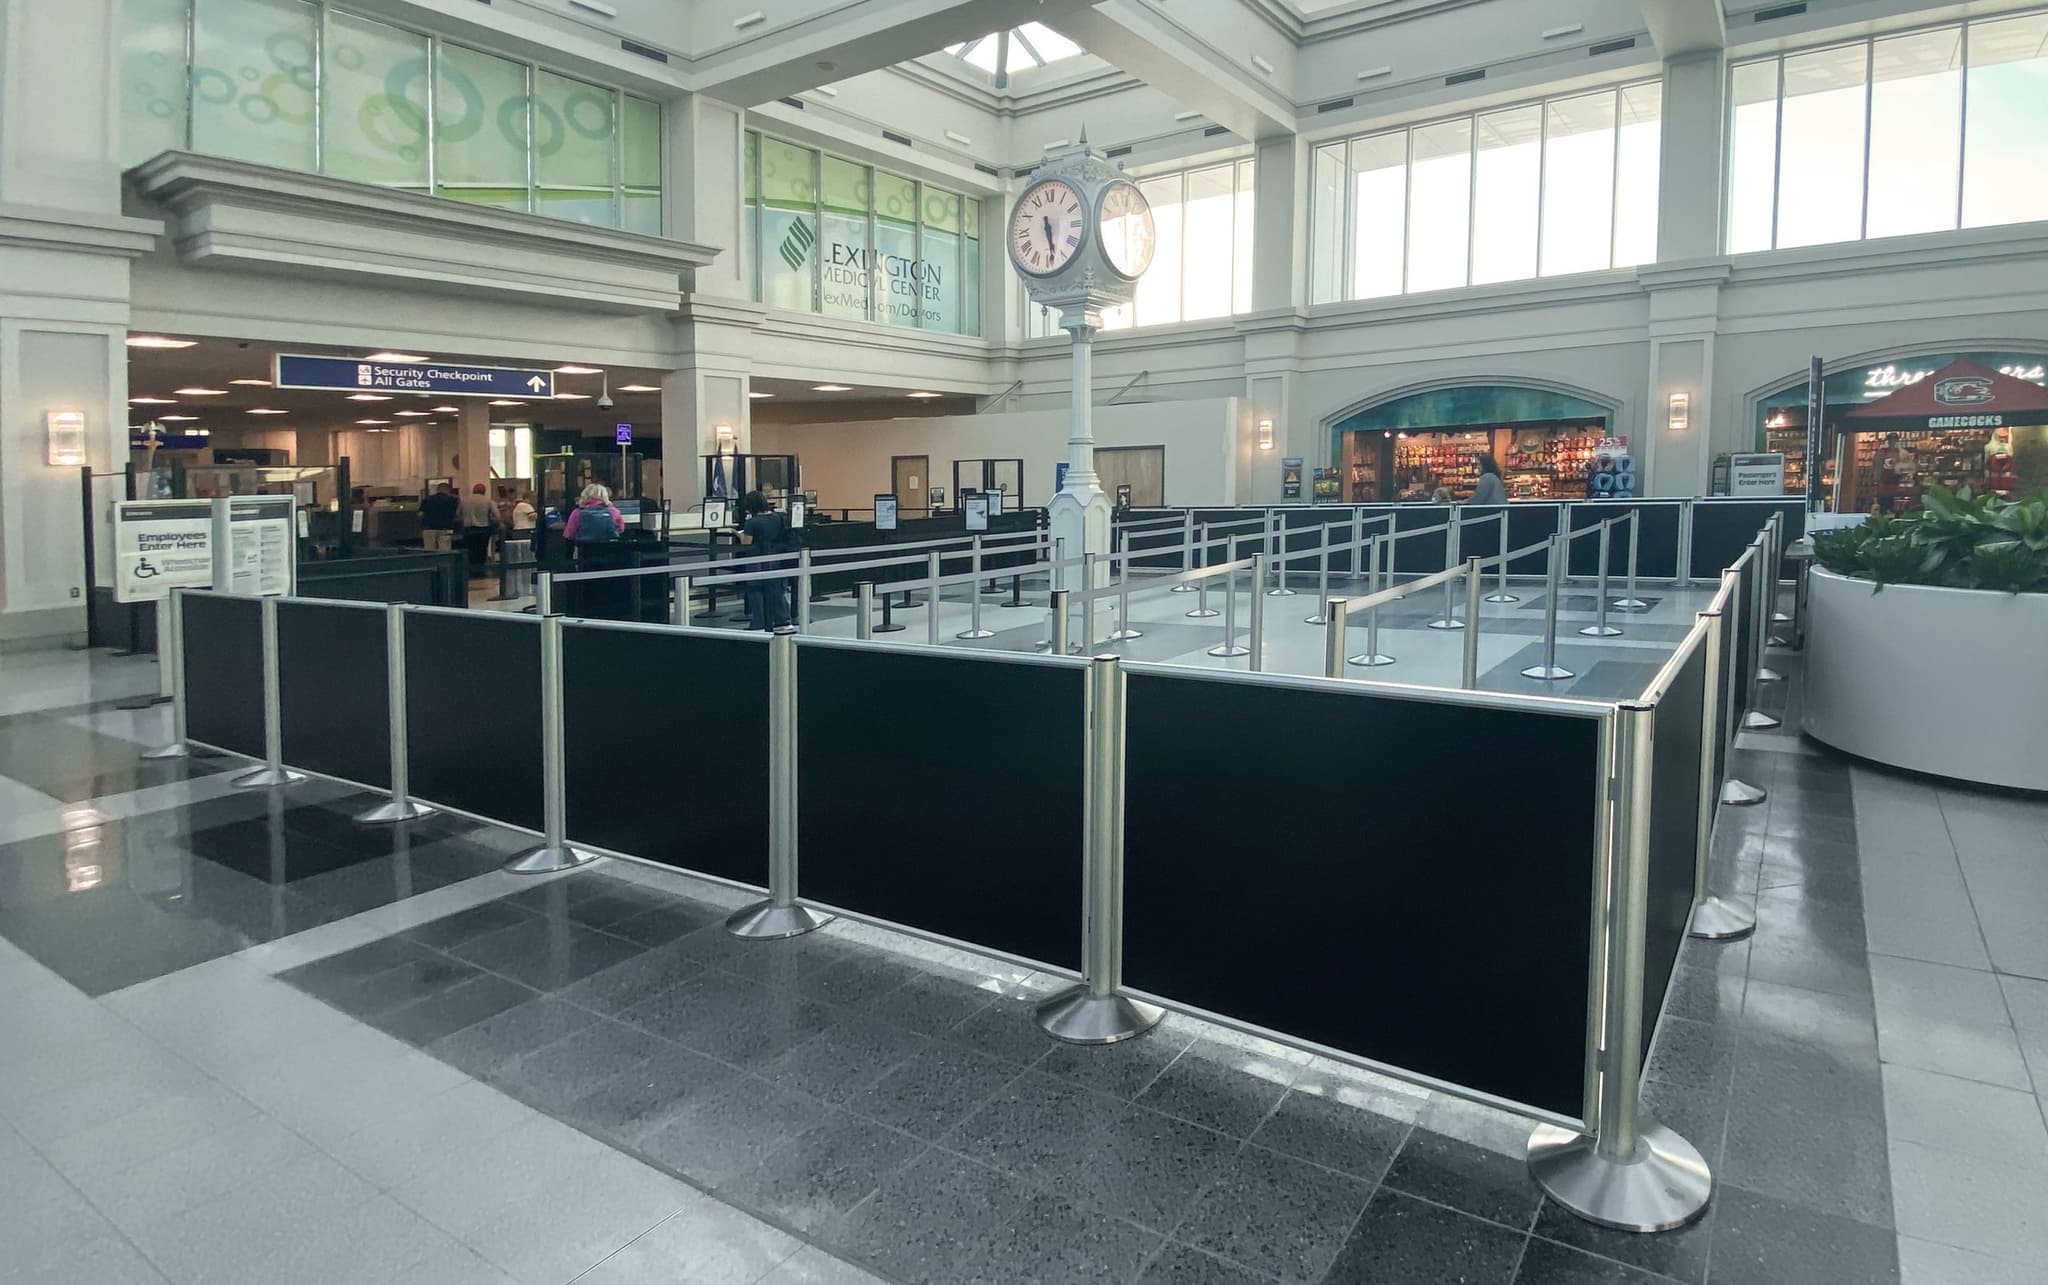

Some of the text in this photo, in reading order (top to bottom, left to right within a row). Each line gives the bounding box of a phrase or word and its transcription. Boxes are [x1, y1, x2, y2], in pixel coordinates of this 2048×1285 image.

[824, 243, 941, 285] EXINGTON
[374, 366, 493, 382] Security Checkpoint
[375, 377, 431, 388] All Gates
[1928, 415, 2002, 428] GAMECOCKS
[138, 532, 207, 543] Employees
[140, 541, 207, 552] Enter Here
